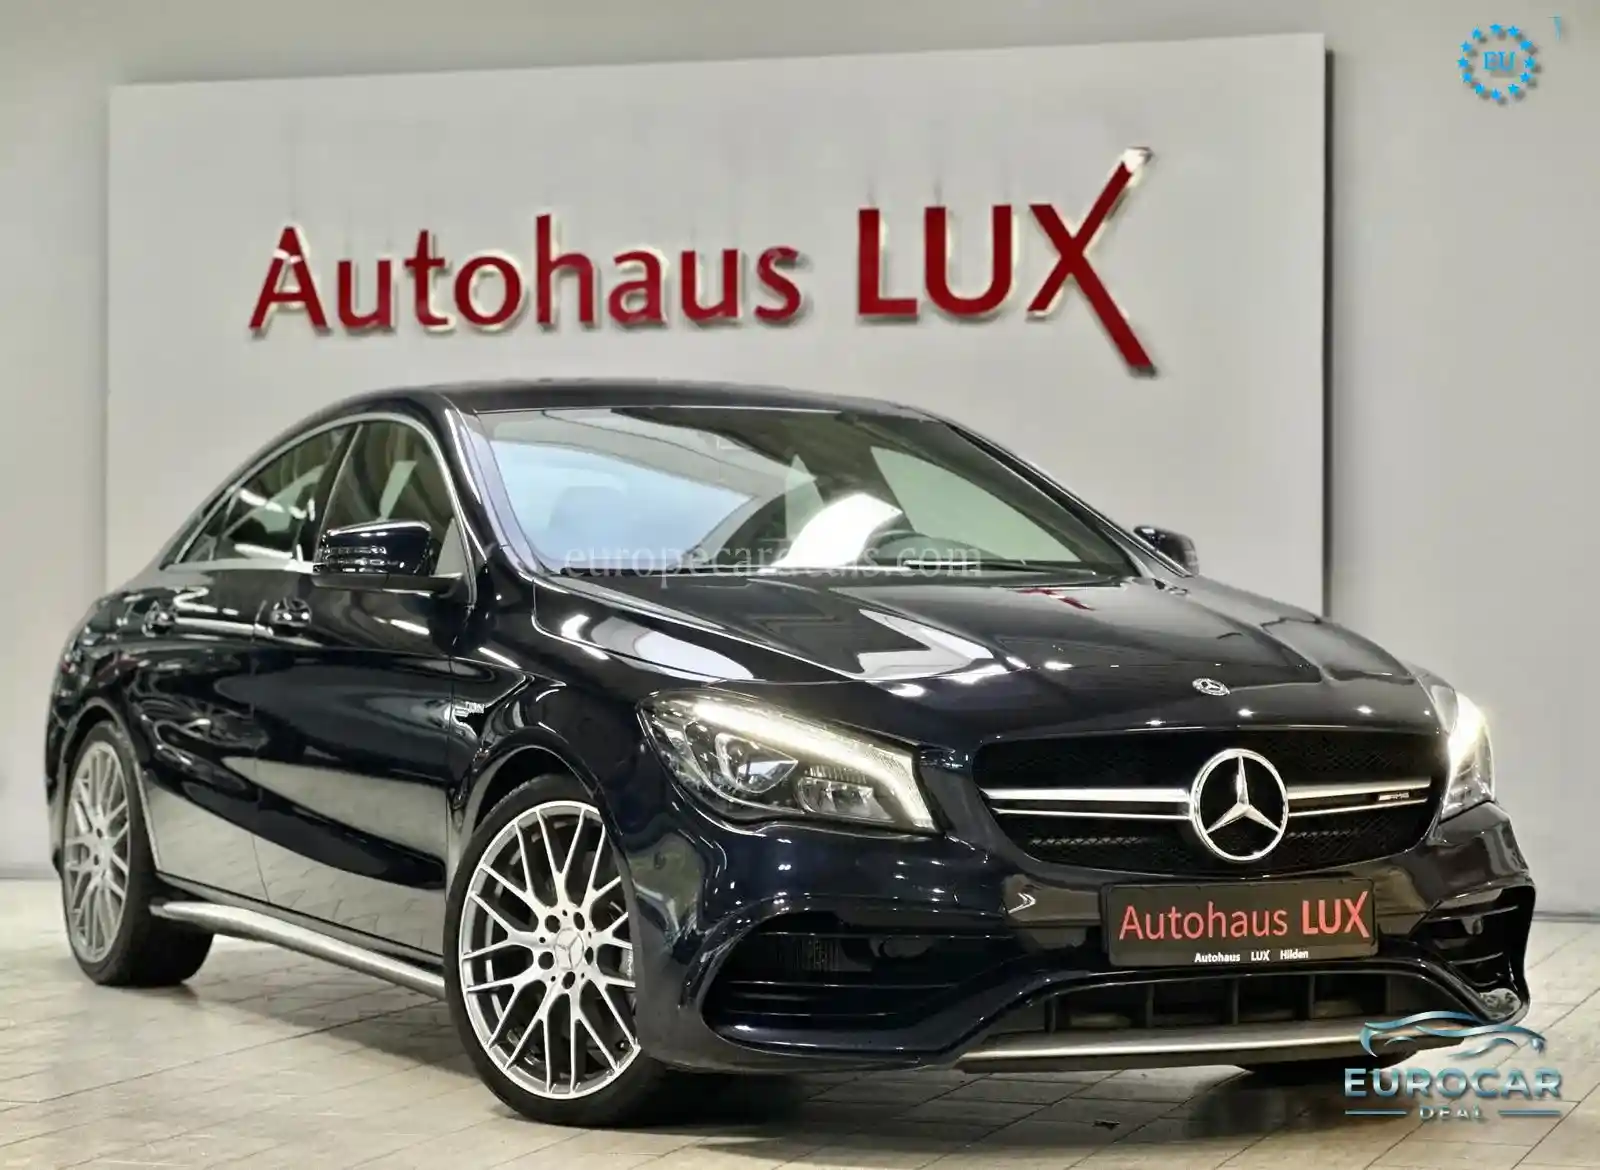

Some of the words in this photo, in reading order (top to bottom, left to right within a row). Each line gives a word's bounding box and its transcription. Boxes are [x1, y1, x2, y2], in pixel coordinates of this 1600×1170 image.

[248, 213, 804, 331] Autohaus
[857, 147, 1154, 372] LUX
[1118, 900, 1289, 941] Autohaus
[1301, 890, 1371, 939] LUX
[1194, 951, 1241, 964] Autohaus
[1250, 950, 1271, 962] LUX
[1279, 948, 1309, 961] Hilden
